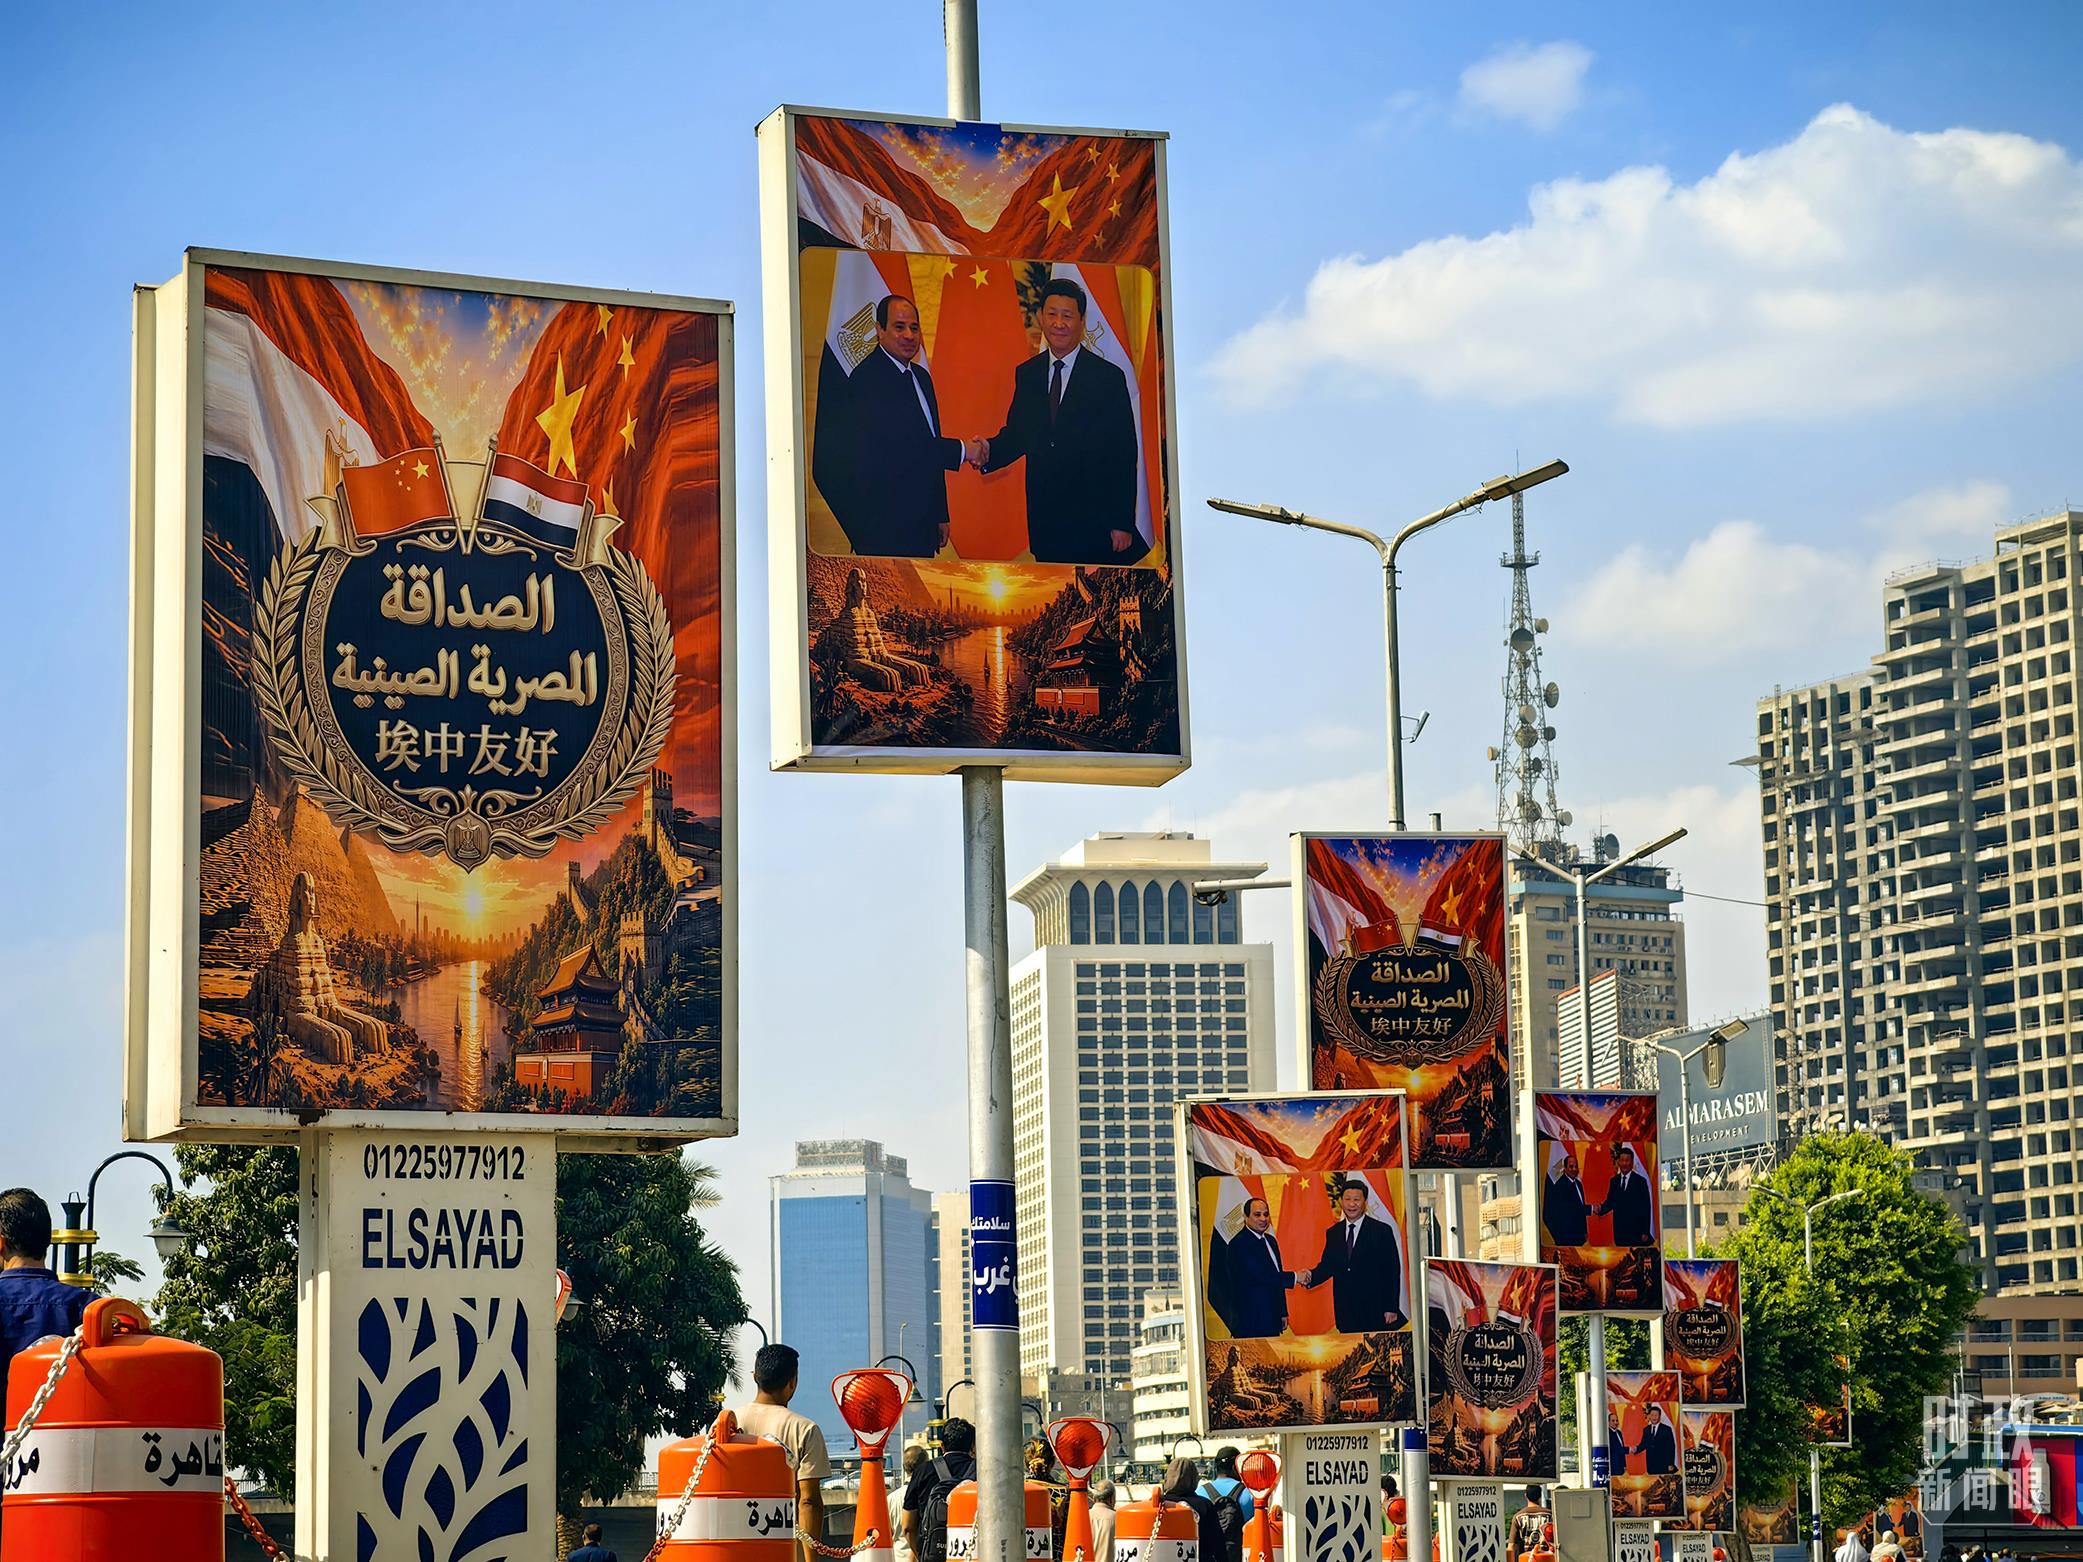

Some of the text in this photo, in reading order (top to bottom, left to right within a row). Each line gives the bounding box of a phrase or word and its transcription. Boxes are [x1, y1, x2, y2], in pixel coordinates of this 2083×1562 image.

[380, 563, 556, 635] الصداقة
[332, 642, 598, 716] المصرية الصينية
[374, 719, 560, 778] 埃中友好
[1371, 961, 1450, 984] الصداقة
[1350, 988, 1470, 1014] المصرية الصينية
[1370, 1017, 1452, 1036] 埃中友好
[1690, 1125, 1750, 1145] EVELOPMENT
[363, 1144, 525, 1180] 01225977912
[362, 1207, 524, 1270] ELSAYAD
[1492, 1353, 1525, 1372] المصرية
[1306, 1435, 1369, 1451] 01225977912
[1306, 1460, 1369, 1485] ELSAYAD
[1457, 1486, 1497, 1496] 01225977912
[1458, 1502, 1497, 1519] ELSAYAD
[1620, 1533, 1649, 1545] ELSAYAD
